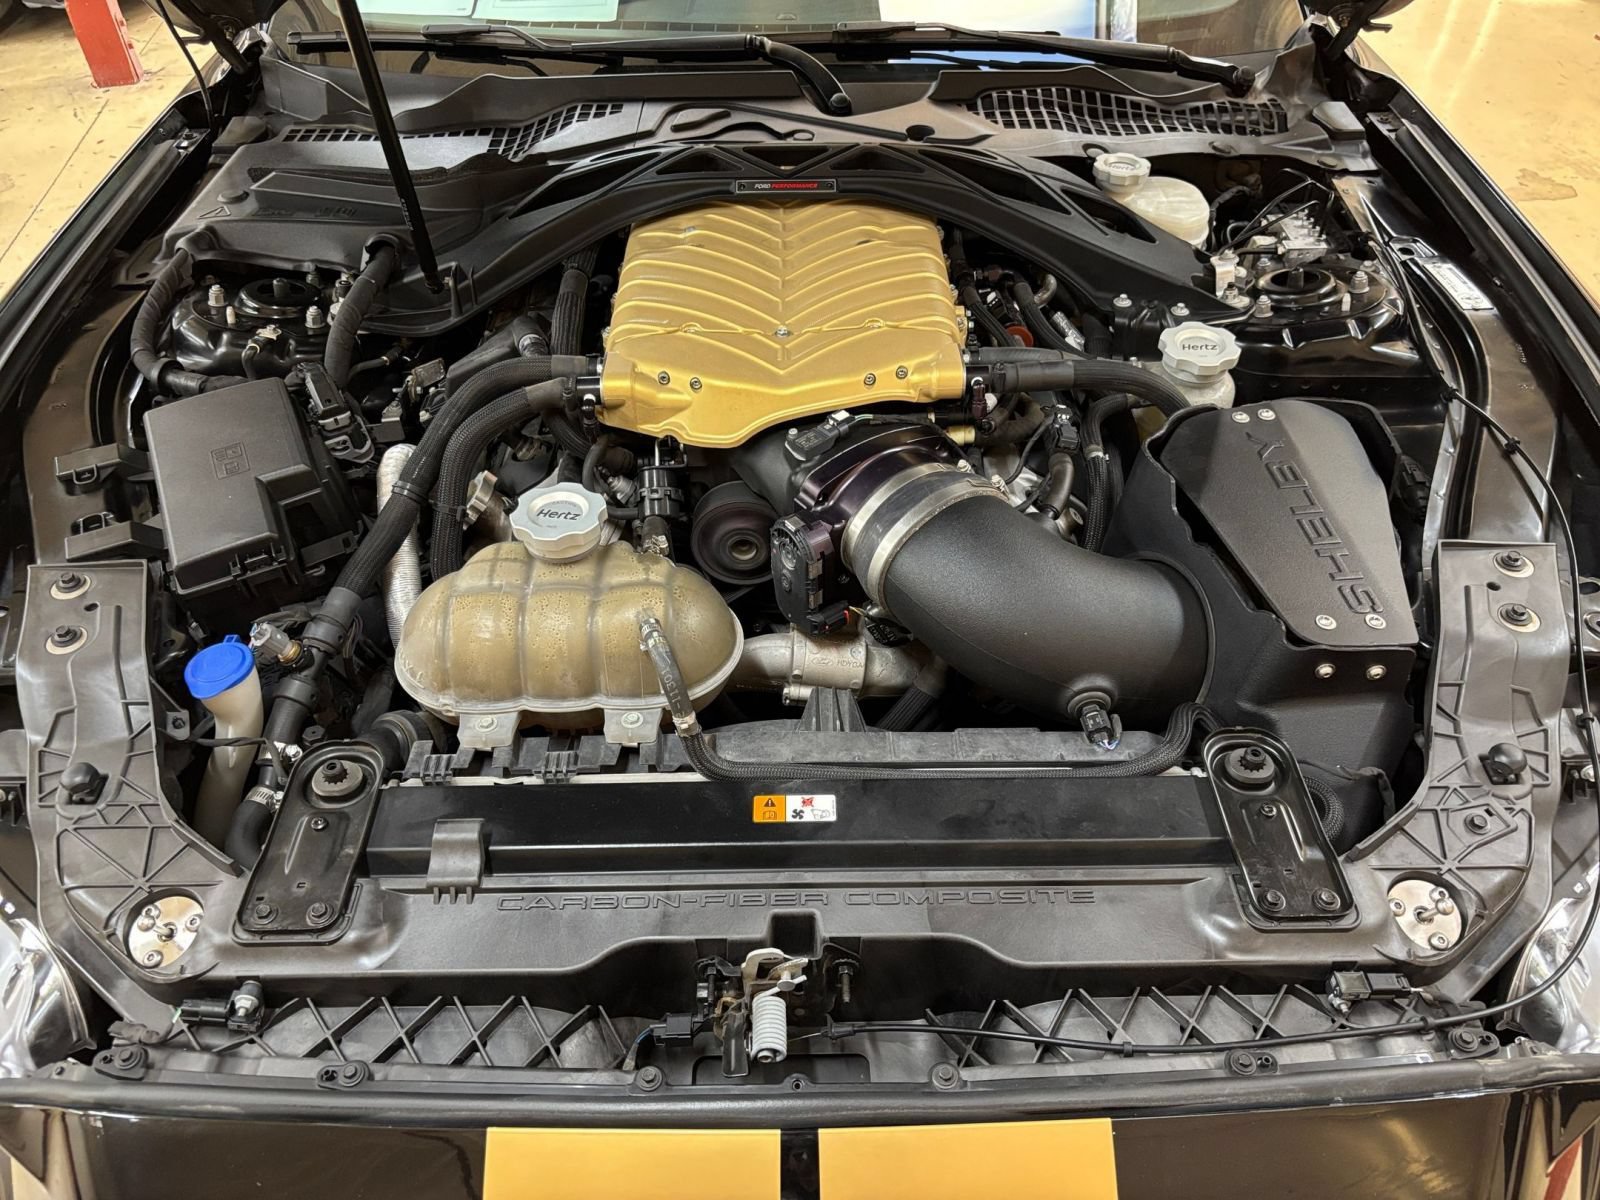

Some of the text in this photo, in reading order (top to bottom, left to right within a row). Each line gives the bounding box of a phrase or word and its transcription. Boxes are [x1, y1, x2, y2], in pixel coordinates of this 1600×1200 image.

[1182, 343, 1218, 351] Hertz
[536, 508, 581, 521] Hertz
[1246, 431, 1384, 613] SHELBY
[496, 888, 1097, 911] CARBON-FIBER COMPOSITE
